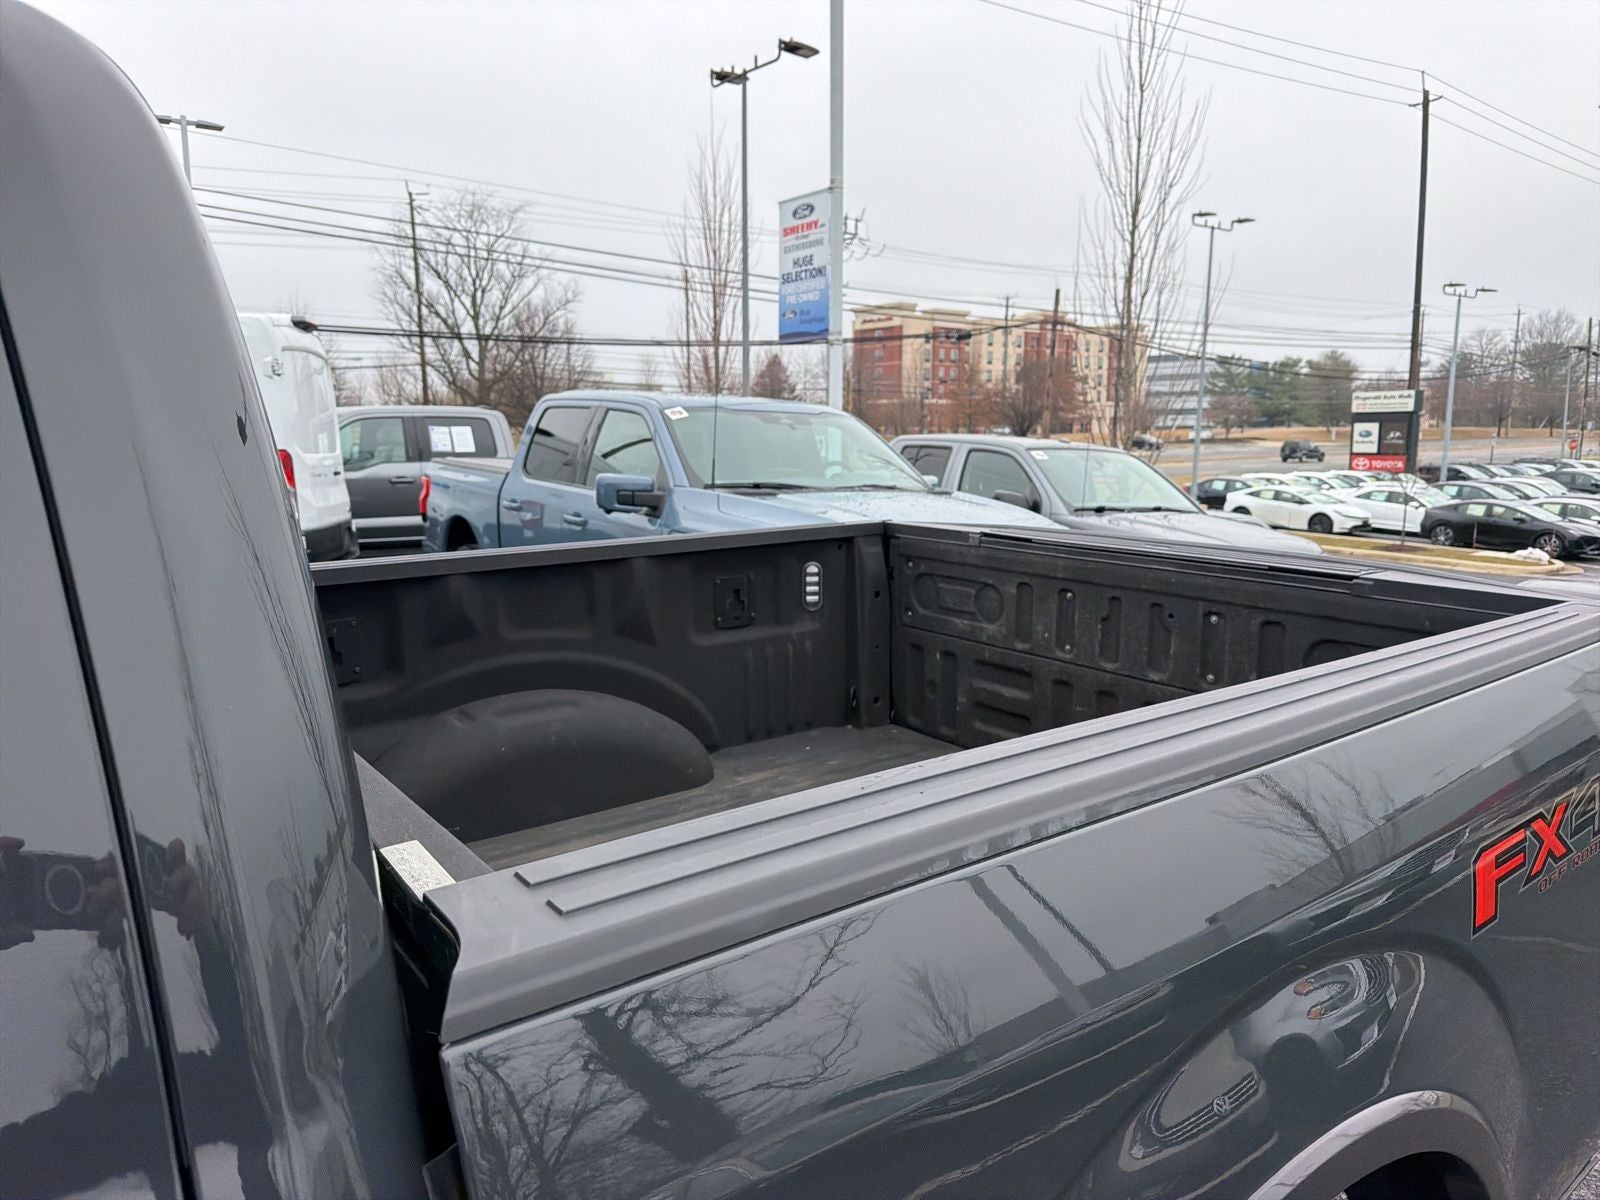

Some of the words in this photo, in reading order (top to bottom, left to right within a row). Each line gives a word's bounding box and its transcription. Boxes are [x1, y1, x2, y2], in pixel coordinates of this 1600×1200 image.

[783, 220, 819, 237] SHEEHY
[793, 254, 814, 269] HUGE
[781, 265, 827, 285] SELECTION!
[1371, 460, 1404, 469] TOYOTA
[1471, 775, 1600, 938] FX4
[1538, 863, 1568, 894] OFF
[1571, 839, 1600, 870] ROA
